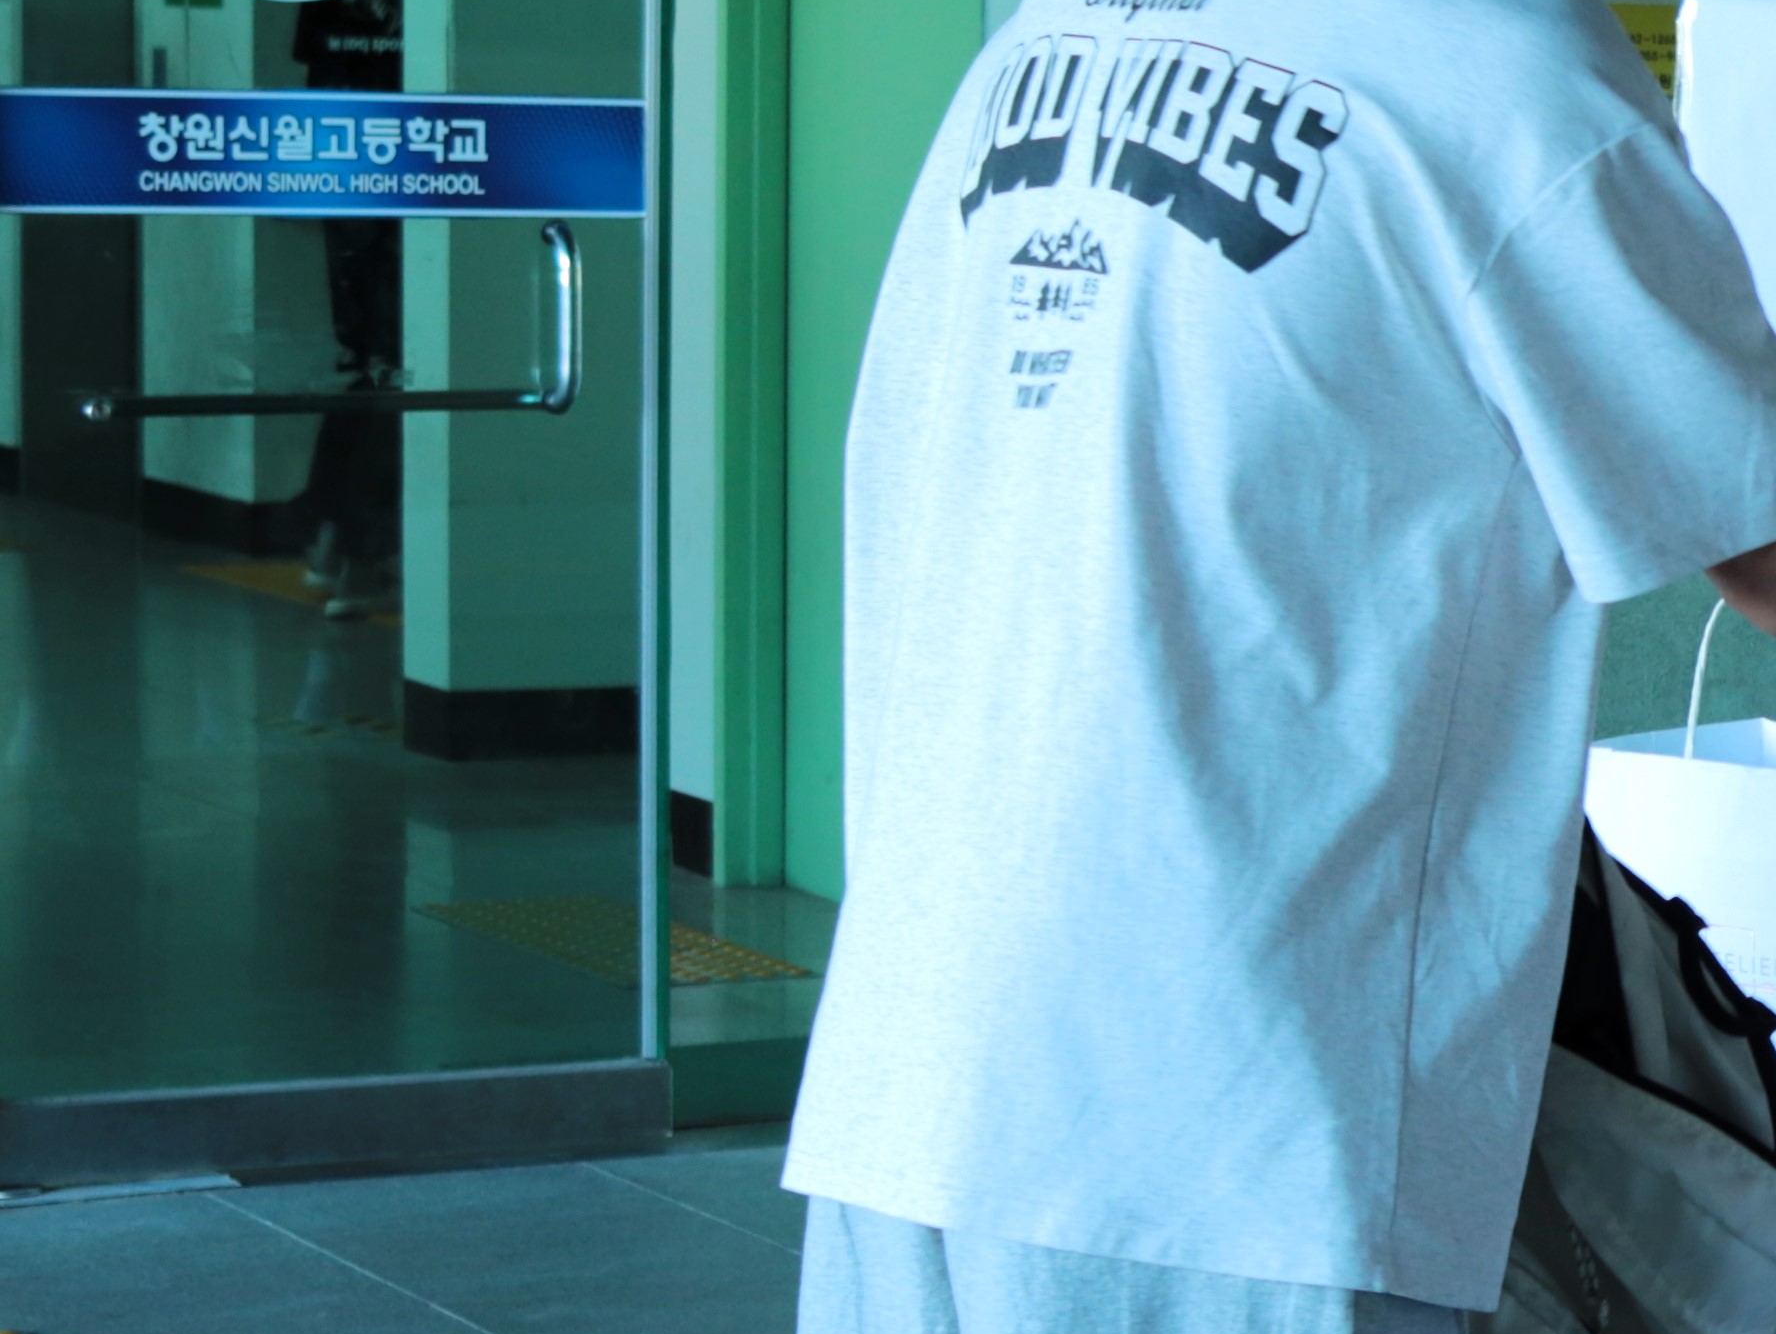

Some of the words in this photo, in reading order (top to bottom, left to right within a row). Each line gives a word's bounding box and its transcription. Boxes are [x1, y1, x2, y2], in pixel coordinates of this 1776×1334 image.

[138, 111, 489, 165] 창원신월고등학교
[1096, 36, 1350, 273] VIBES
[138, 170, 263, 193] CHANGWON
[266, 172, 346, 195] SINWOL
[348, 173, 399, 195] HIGH
[402, 174, 486, 196] SCHOOL
